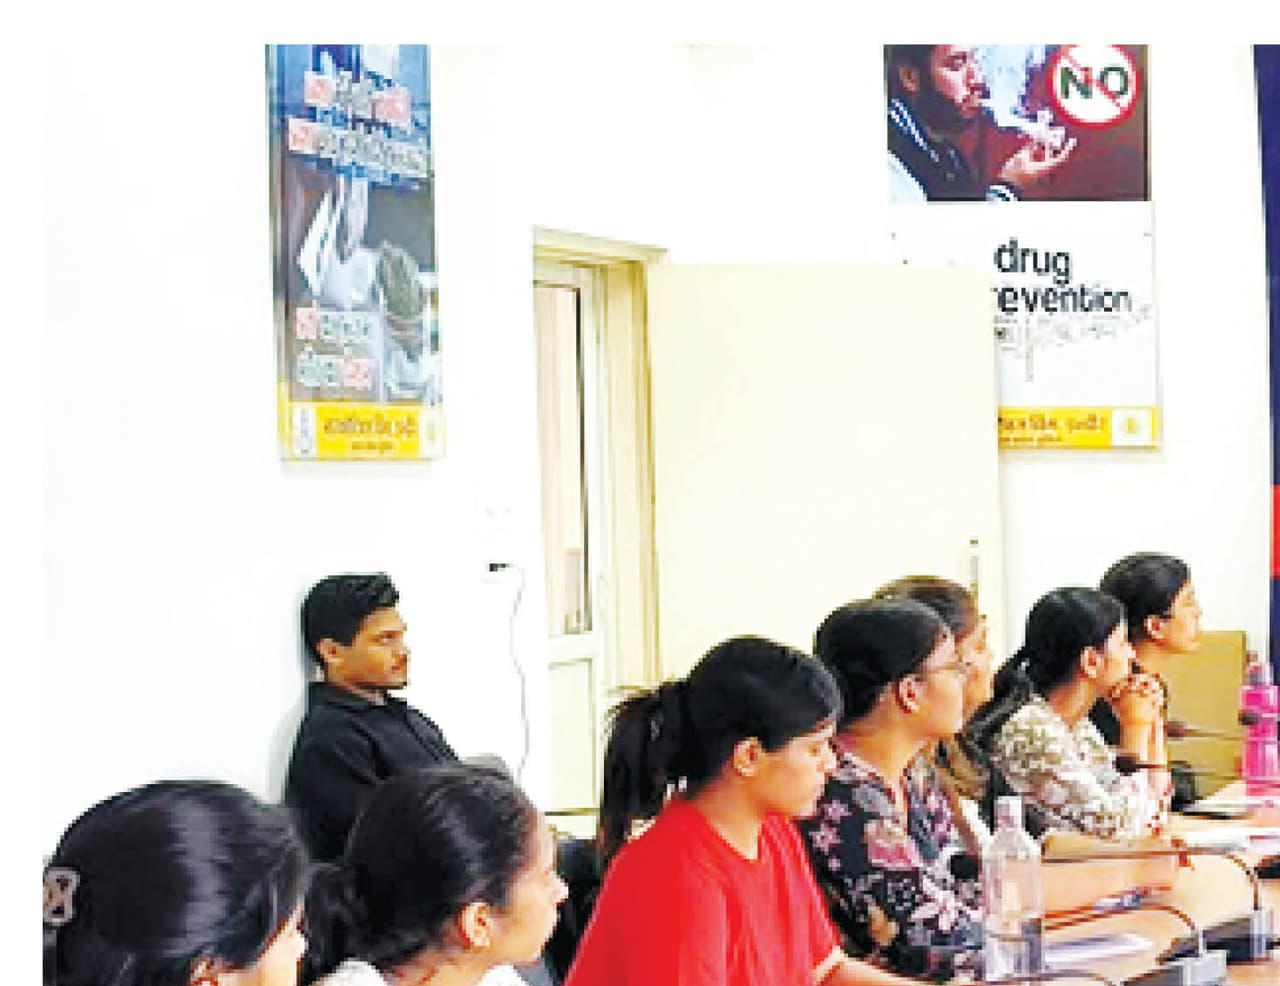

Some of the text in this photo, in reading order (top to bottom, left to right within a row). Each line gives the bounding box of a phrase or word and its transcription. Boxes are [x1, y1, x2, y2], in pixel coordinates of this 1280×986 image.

[1060, 66, 1129, 99] NO
[993, 237, 1072, 285] drug
[992, 284, 1131, 313] evention
